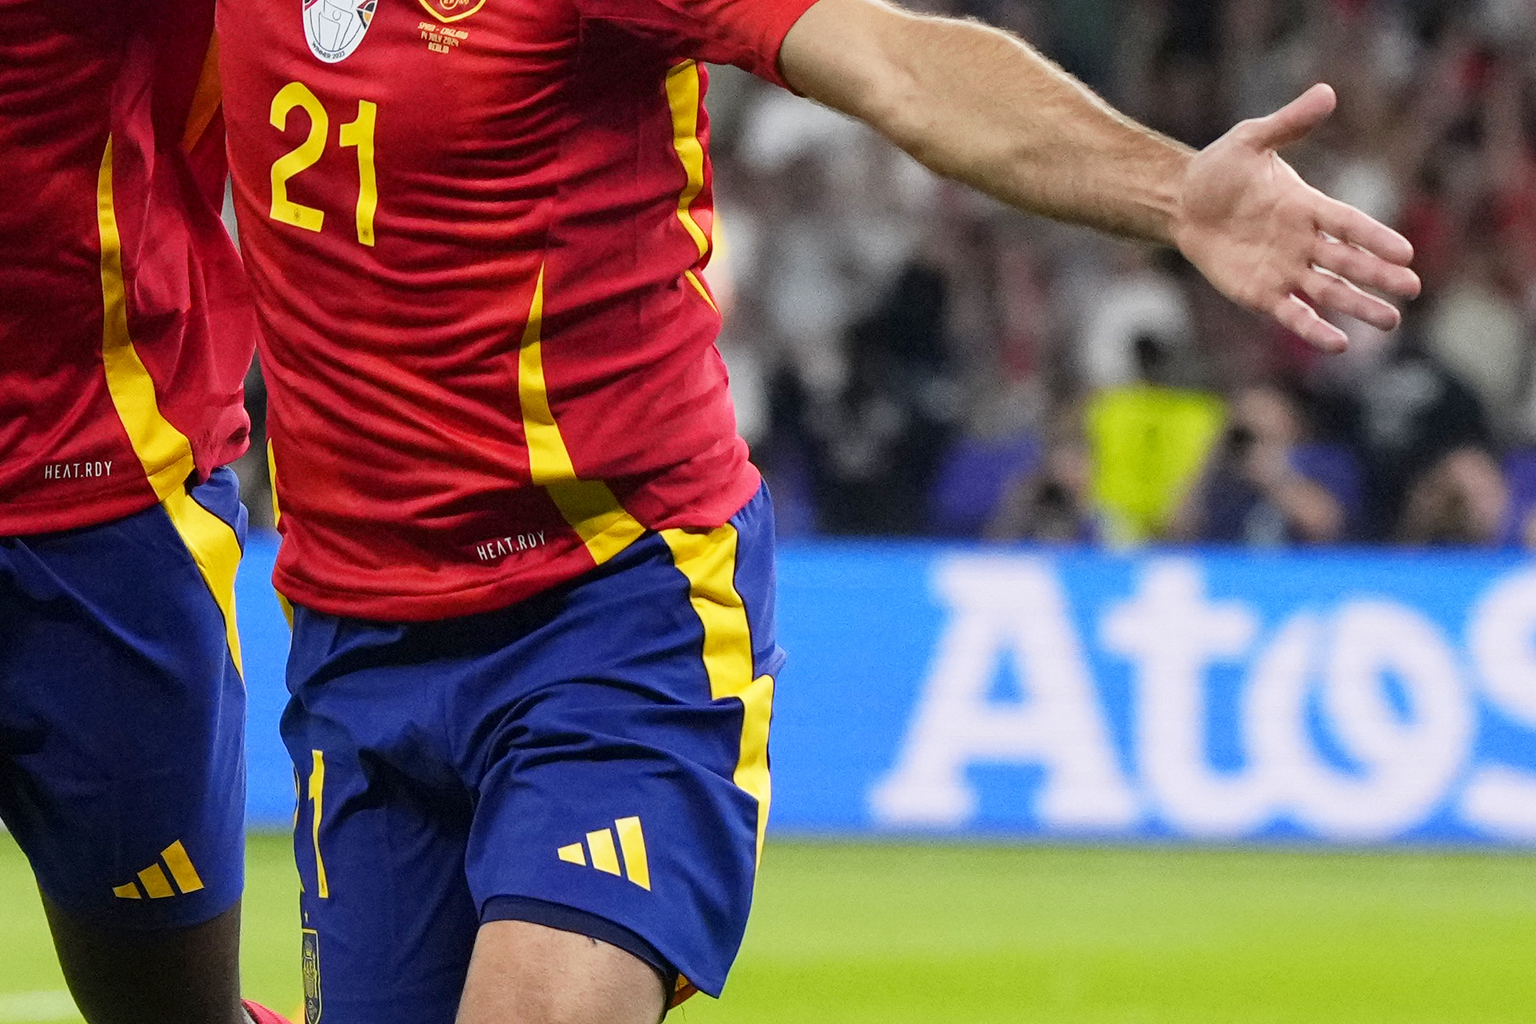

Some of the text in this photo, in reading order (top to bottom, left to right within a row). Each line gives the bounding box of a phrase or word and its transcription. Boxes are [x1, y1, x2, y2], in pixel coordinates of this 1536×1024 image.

[417, 21, 436, 32] SPAIN
[440, 27, 469, 40] ENGLAND
[312, 41, 331, 59] WINNER
[428, 42, 450, 55] BERLIN
[429, 33, 443, 44] JULY
[443, 35, 459, 48] 2024
[269, 81, 378, 247] 21
[44, 460, 113, 480] HEAT.RDY
[476, 529, 546, 561] HEAT.RDY
